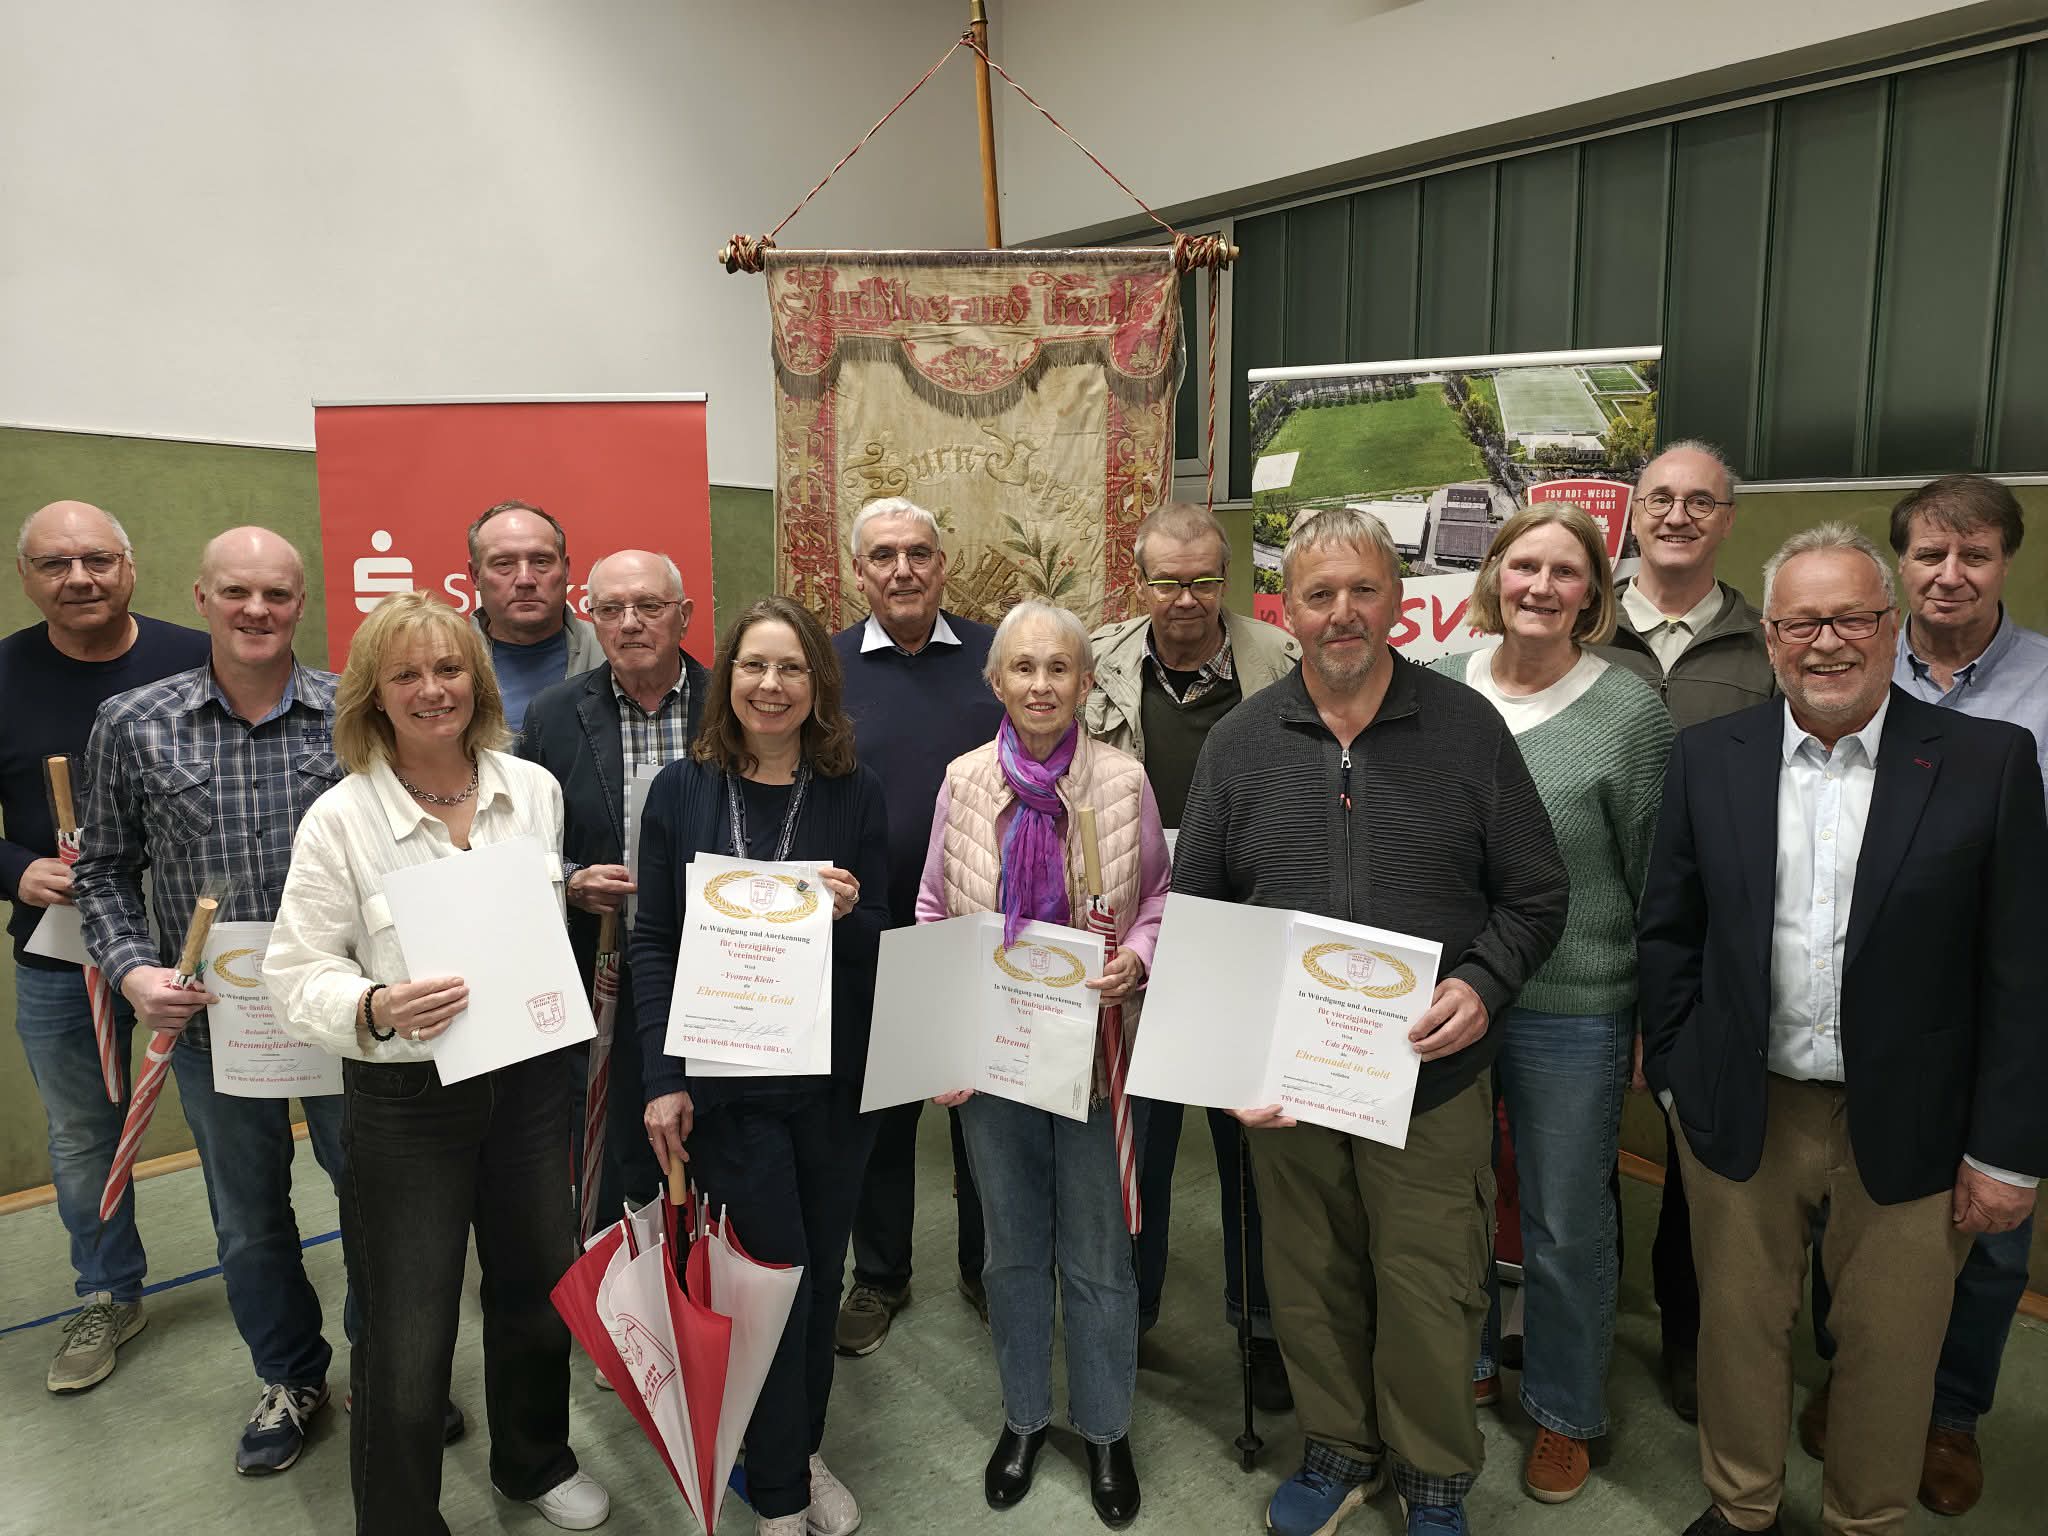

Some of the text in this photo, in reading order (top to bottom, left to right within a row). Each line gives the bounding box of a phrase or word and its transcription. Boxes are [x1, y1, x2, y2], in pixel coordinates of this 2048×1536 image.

[1546, 489, 1562, 498] TSV
[1596, 500, 1616, 510] 1881
[1386, 594, 1473, 648] SV
[709, 924, 748, 937] Würdigung
[750, 930, 763, 938] und
[765, 932, 811, 944] Anerkennung
[728, 950, 776, 962] Vereinstreue
[754, 974, 774, 984] Klein
[696, 986, 794, 1006] Ehrennadel in Gold
[1002, 984, 1032, 997] Würdigung
[1046, 994, 1082, 1008] Anerkennung
[1298, 990, 1408, 1022] In Würdigung und Anerkennung
[1318, 1007, 1384, 1028] für vierzigjährige
[1325, 1018, 1373, 1036] Vereinstreue
[730, 1041, 761, 1051] Auerbach
[1342, 1043, 1368, 1056] Philipp
[1296, 1049, 1392, 1080] Ehrennadel in Gold
[1280, 1094, 1294, 1102] TSV
[1326, 1106, 1357, 1118] Auerbach
